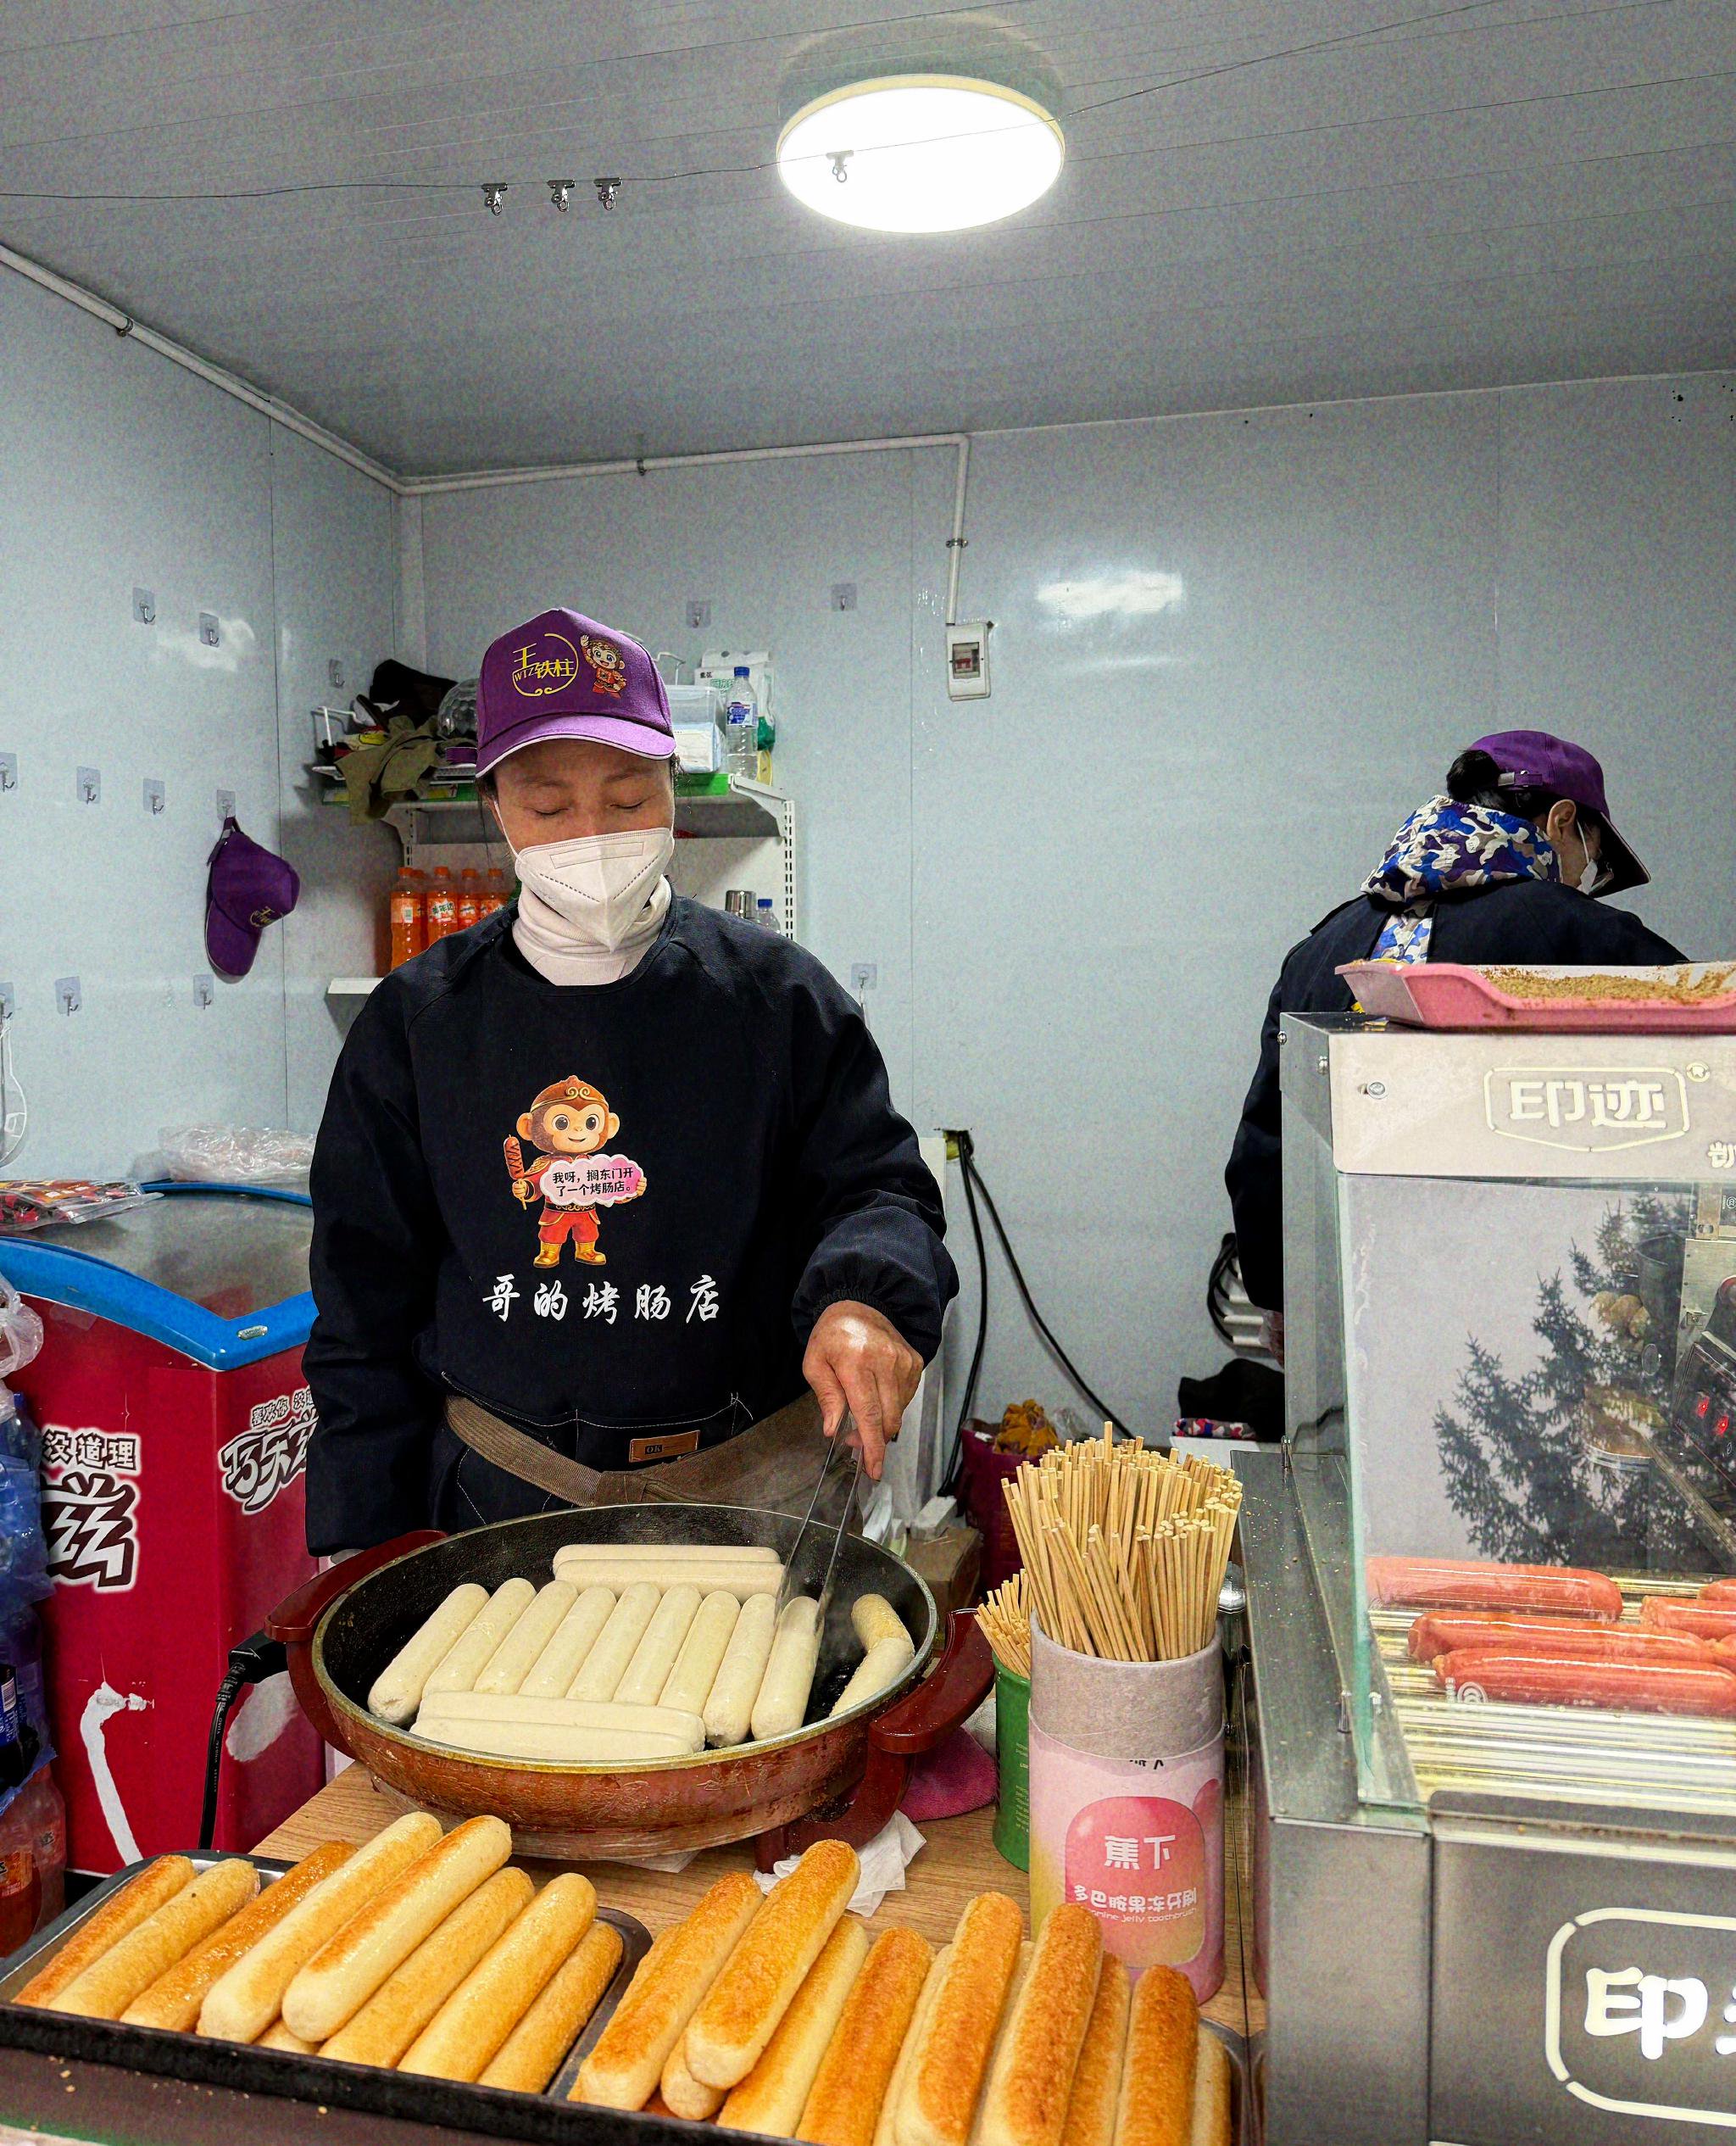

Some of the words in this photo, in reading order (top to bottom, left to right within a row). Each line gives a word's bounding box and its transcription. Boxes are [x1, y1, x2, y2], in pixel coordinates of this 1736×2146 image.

[1510, 1080, 1666, 1129] 印迹
[556, 1180, 631, 1197] 了一个烤肠店。
[482, 1274, 721, 1324] 哥的烤肠店
[252, 1398, 288, 1427] 喜欢你
[43, 1429, 136, 1471] 没道理
[1104, 1834, 1177, 1870] 蕉下
[1121, 1915, 1144, 1924] jelly
[1583, 1965, 1736, 2060] 印
